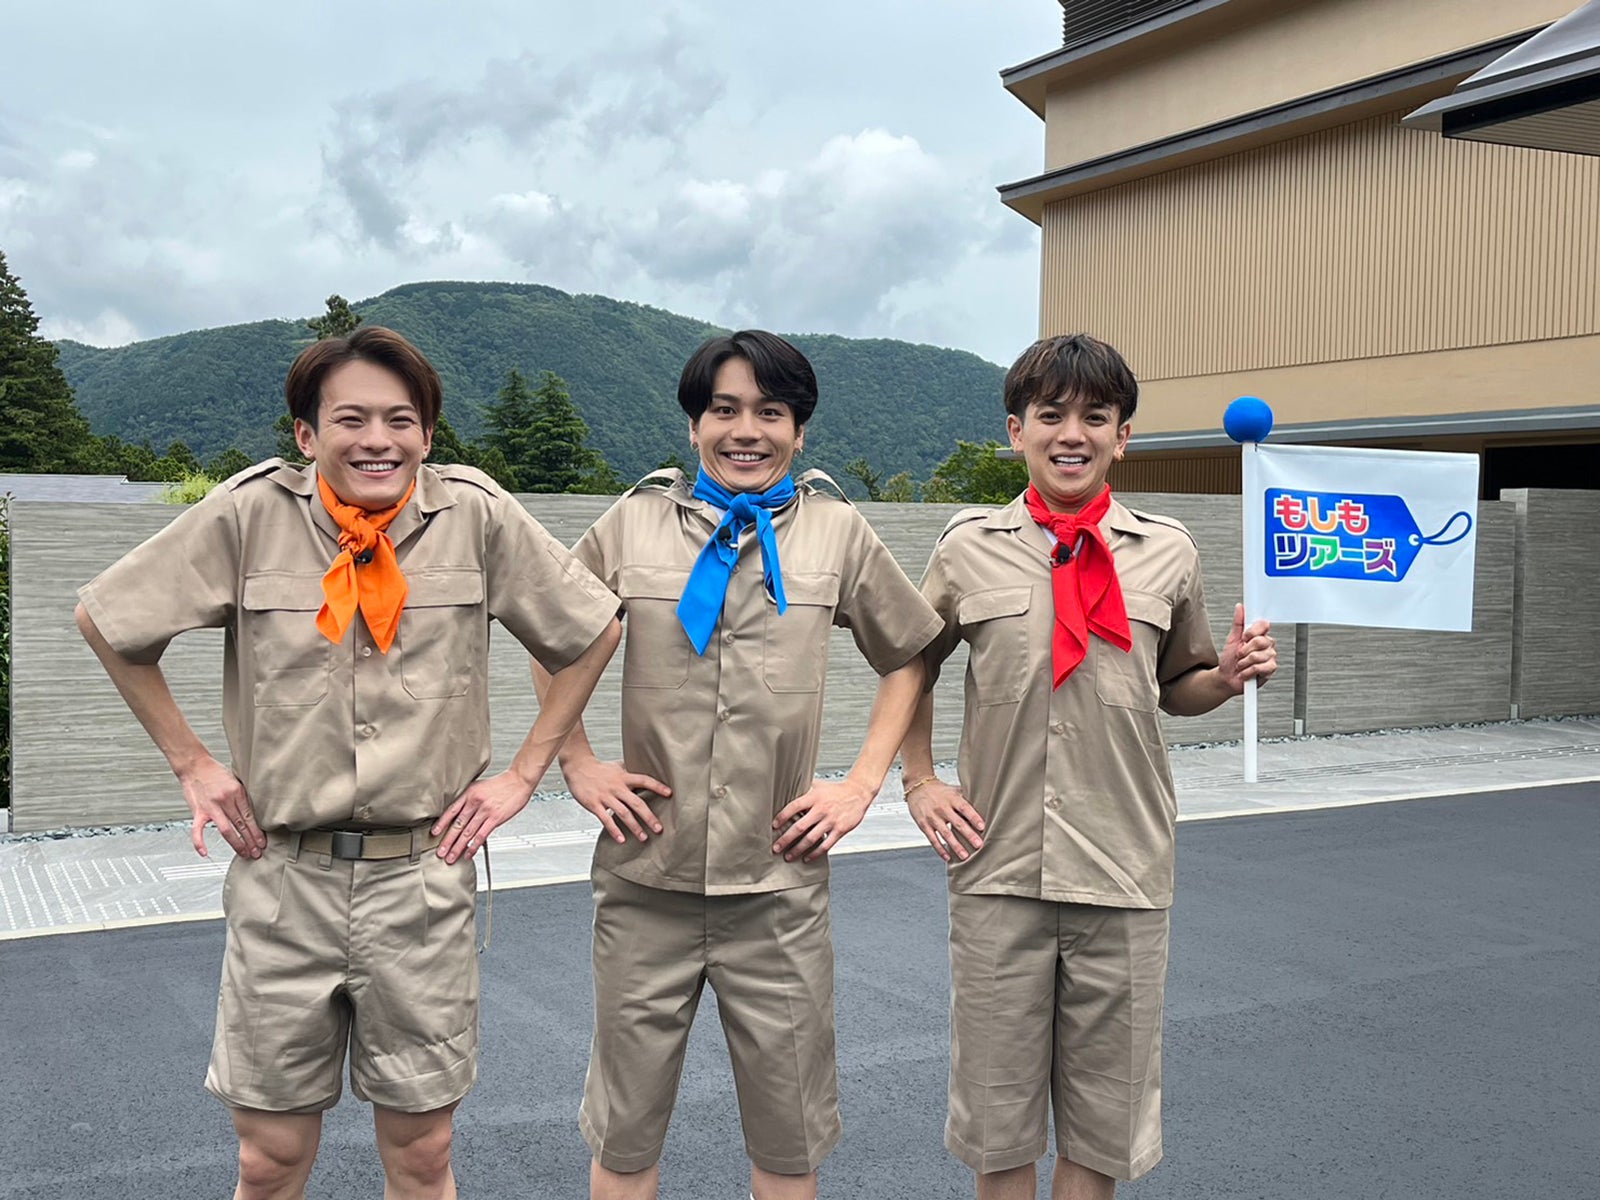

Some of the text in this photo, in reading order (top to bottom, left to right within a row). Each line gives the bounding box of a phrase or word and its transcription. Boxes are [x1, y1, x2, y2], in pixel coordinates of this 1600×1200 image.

[1274, 494, 1369, 535] もしも
[1274, 534, 1397, 577] ツアーズ
